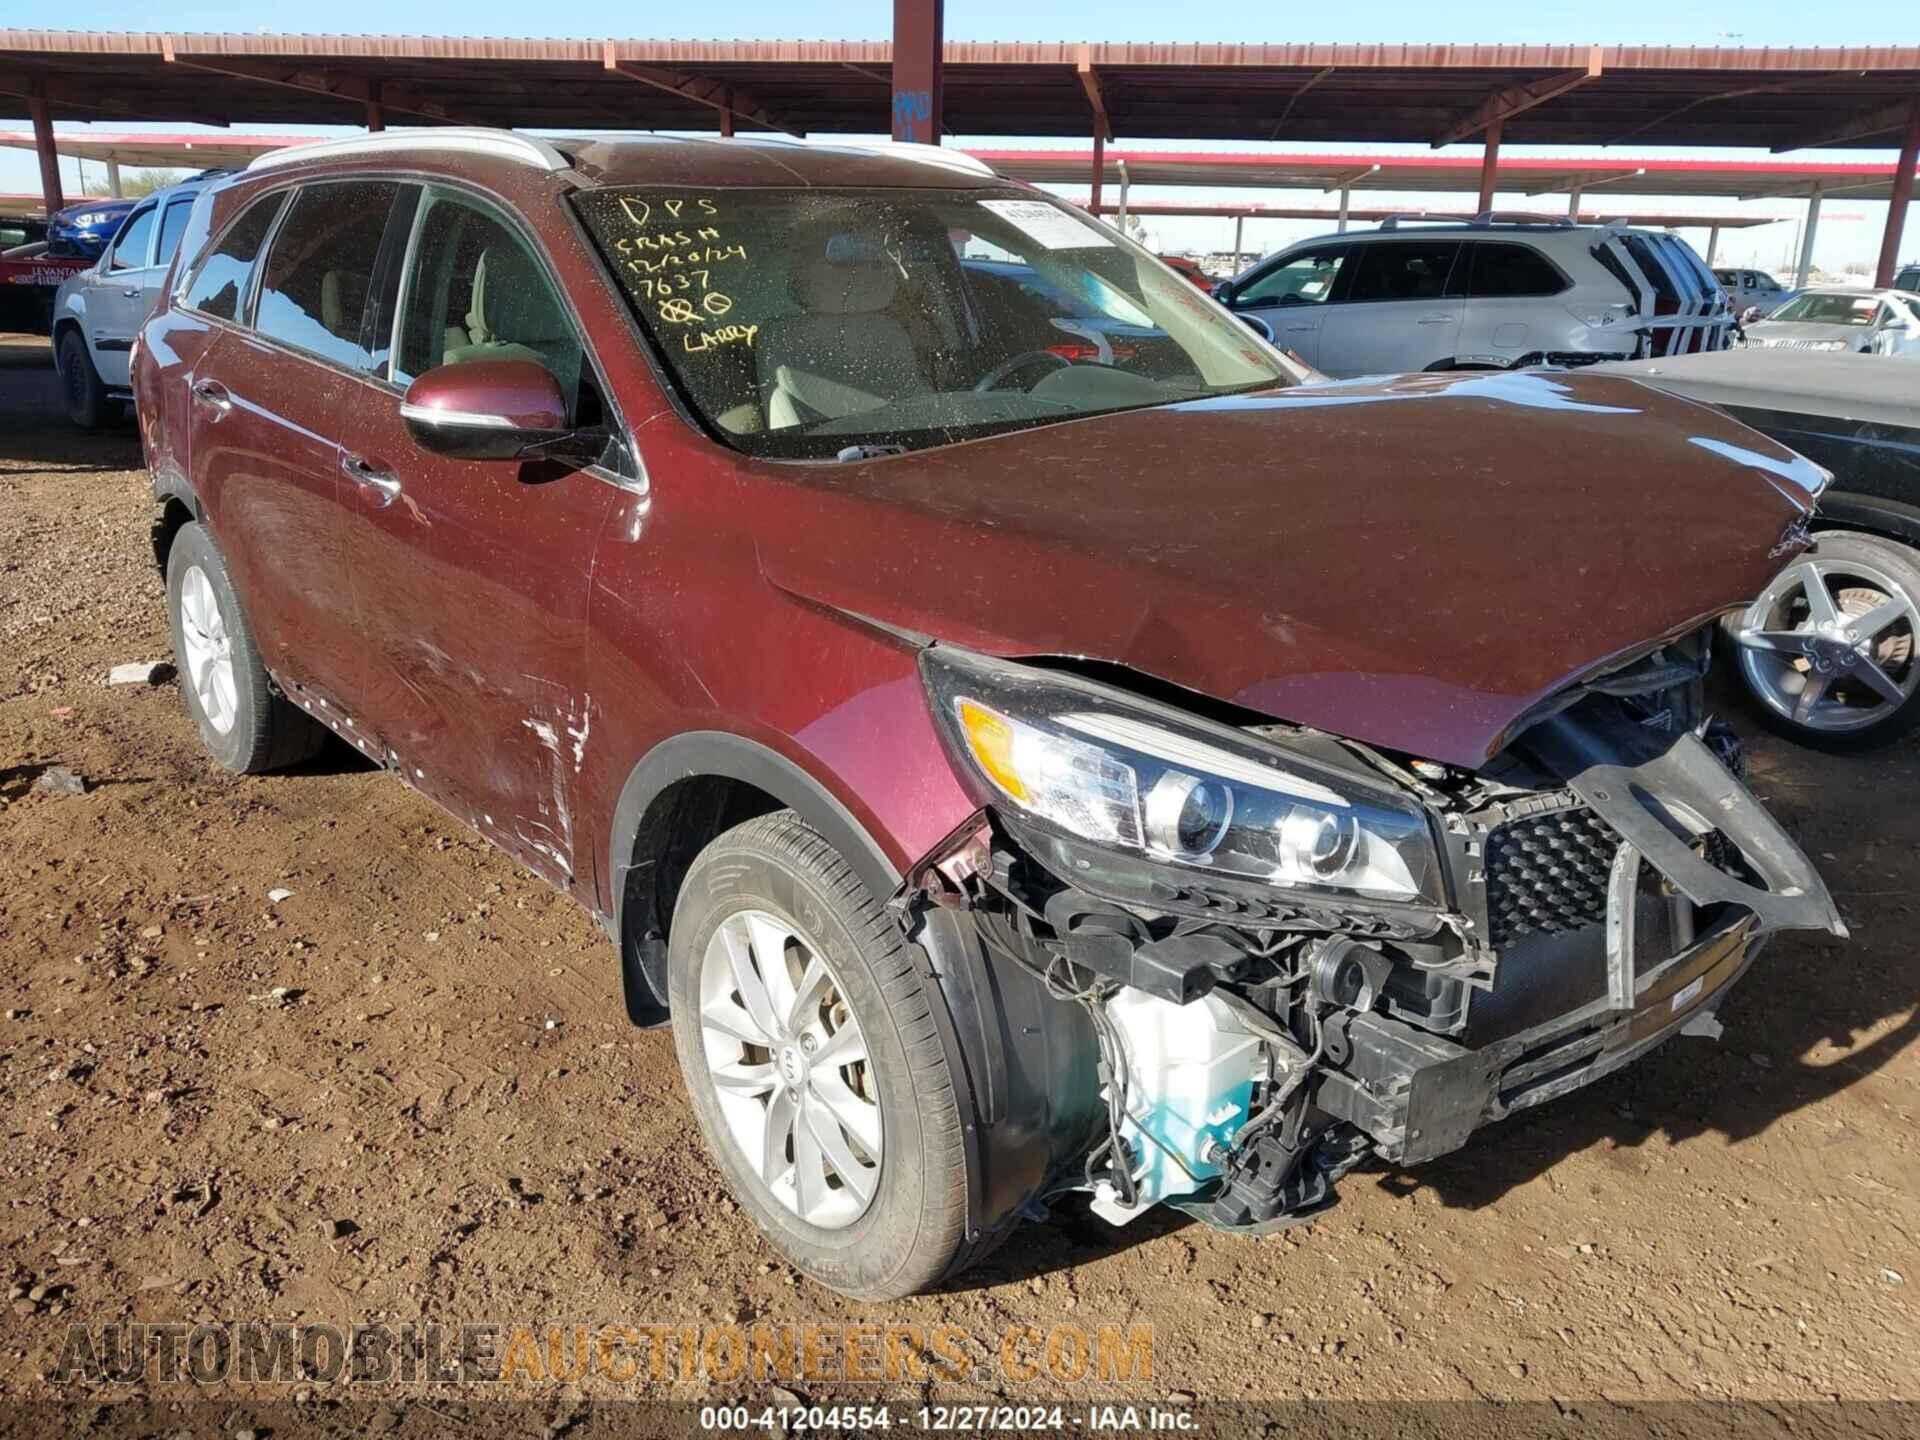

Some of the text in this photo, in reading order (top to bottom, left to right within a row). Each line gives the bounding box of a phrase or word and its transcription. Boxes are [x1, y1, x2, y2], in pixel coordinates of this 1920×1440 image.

[617, 227, 720, 254] CRASH
[639, 270, 709, 298] 7637
[684, 324, 758, 351] LARRY
